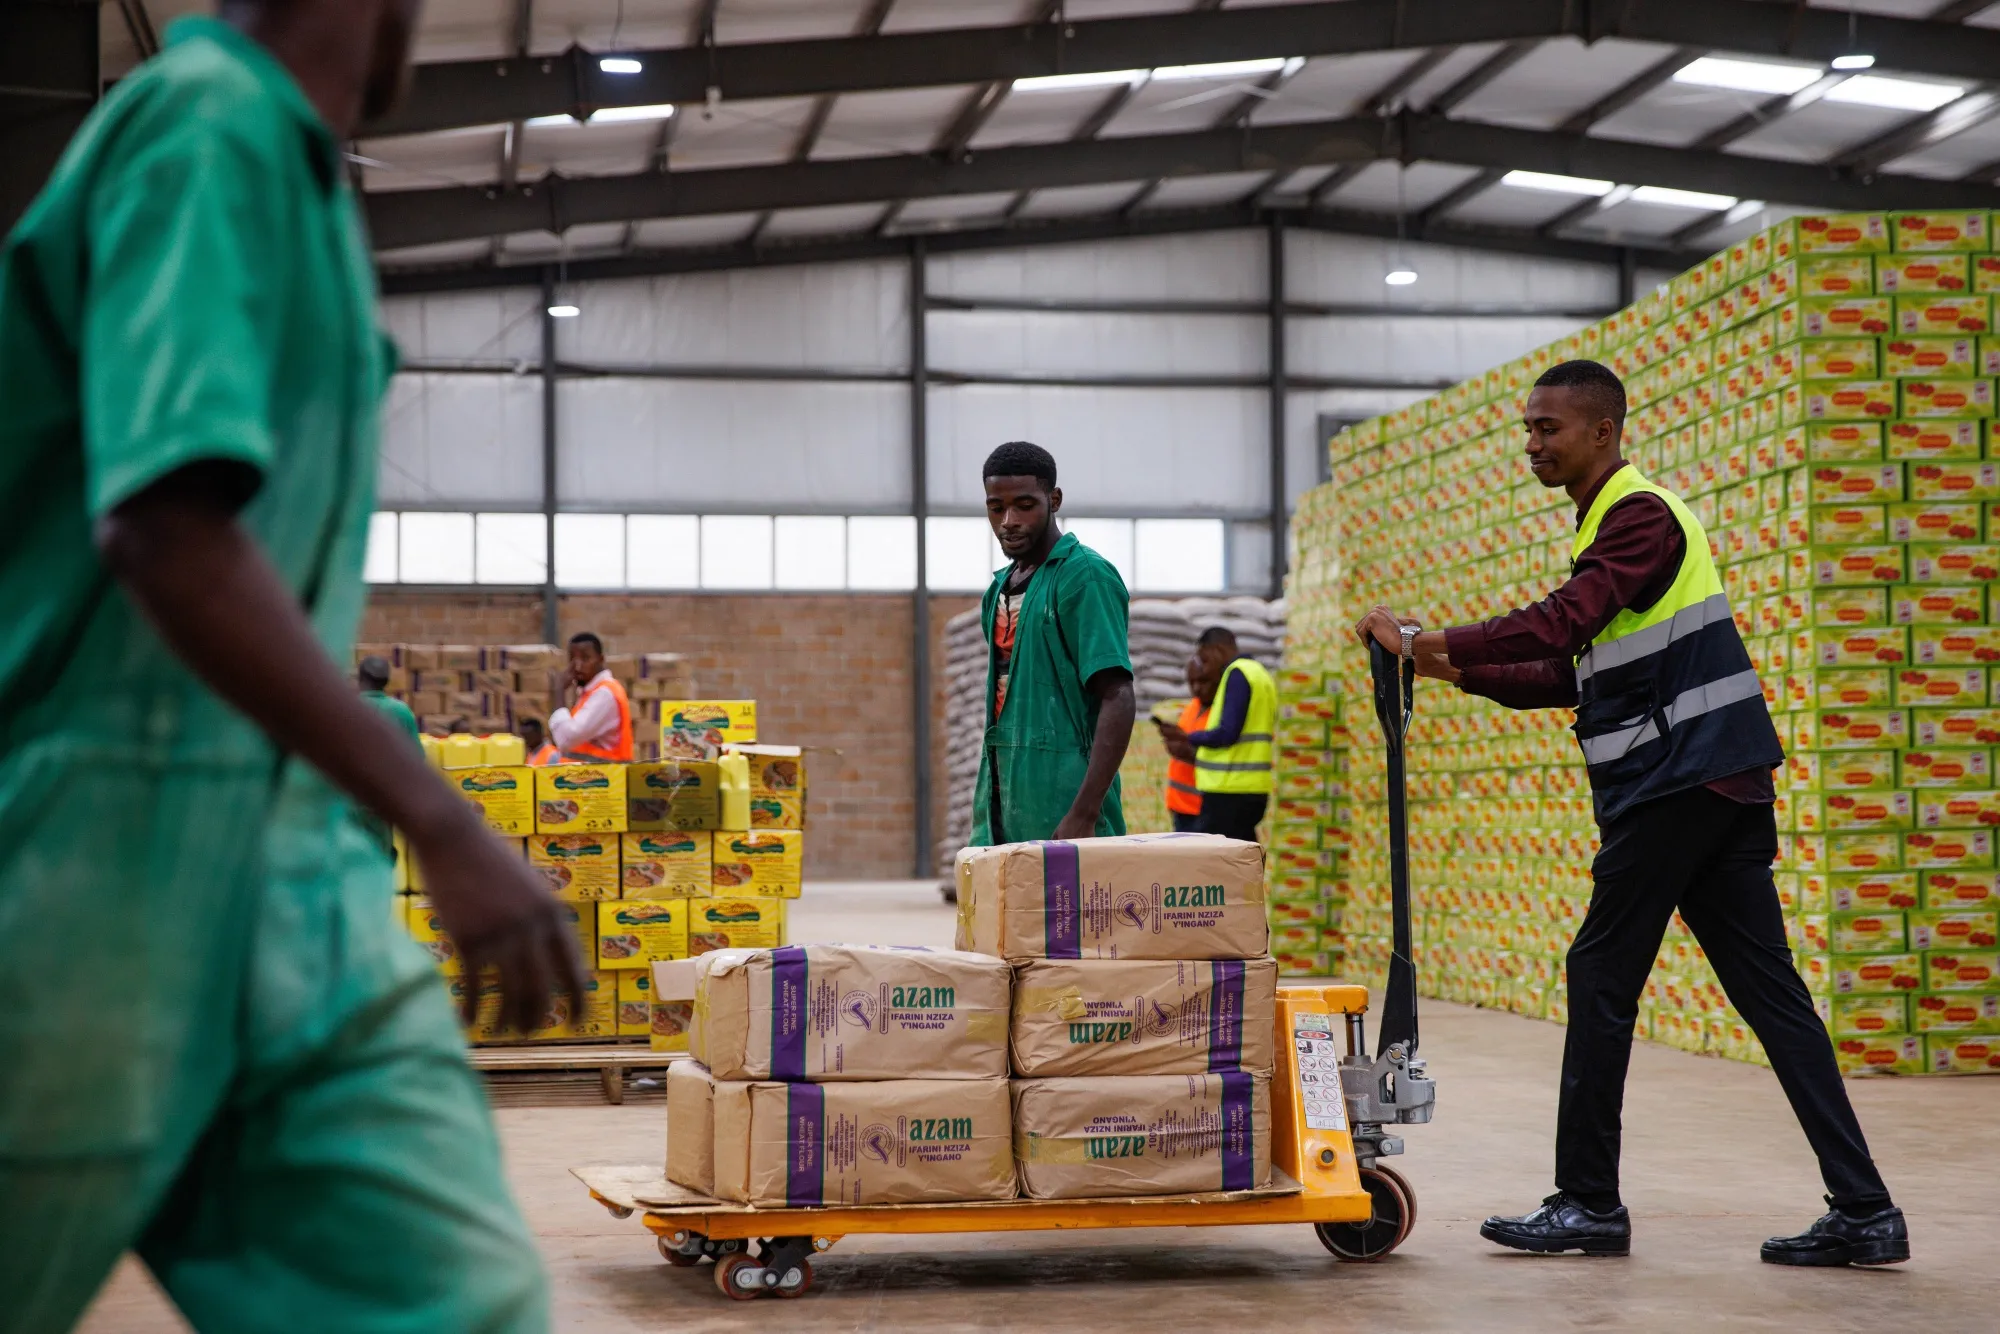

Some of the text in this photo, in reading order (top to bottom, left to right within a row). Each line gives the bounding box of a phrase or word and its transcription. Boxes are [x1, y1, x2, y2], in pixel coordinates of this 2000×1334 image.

[1164, 885, 1225, 907] azam
[1164, 912, 1195, 920] IFARINI
[1173, 919, 1215, 928] Y'INGANO
[892, 987, 955, 1009] azam
[926, 1013, 954, 1021] NZIZA
[901, 1022, 945, 1030] Y'INGANO
[1069, 1022, 1131, 1044] azam
[910, 1117, 973, 1140] azam
[1114, 1124, 1145, 1132] IFARINI
[918, 1154, 961, 1162] Y'INGANO
